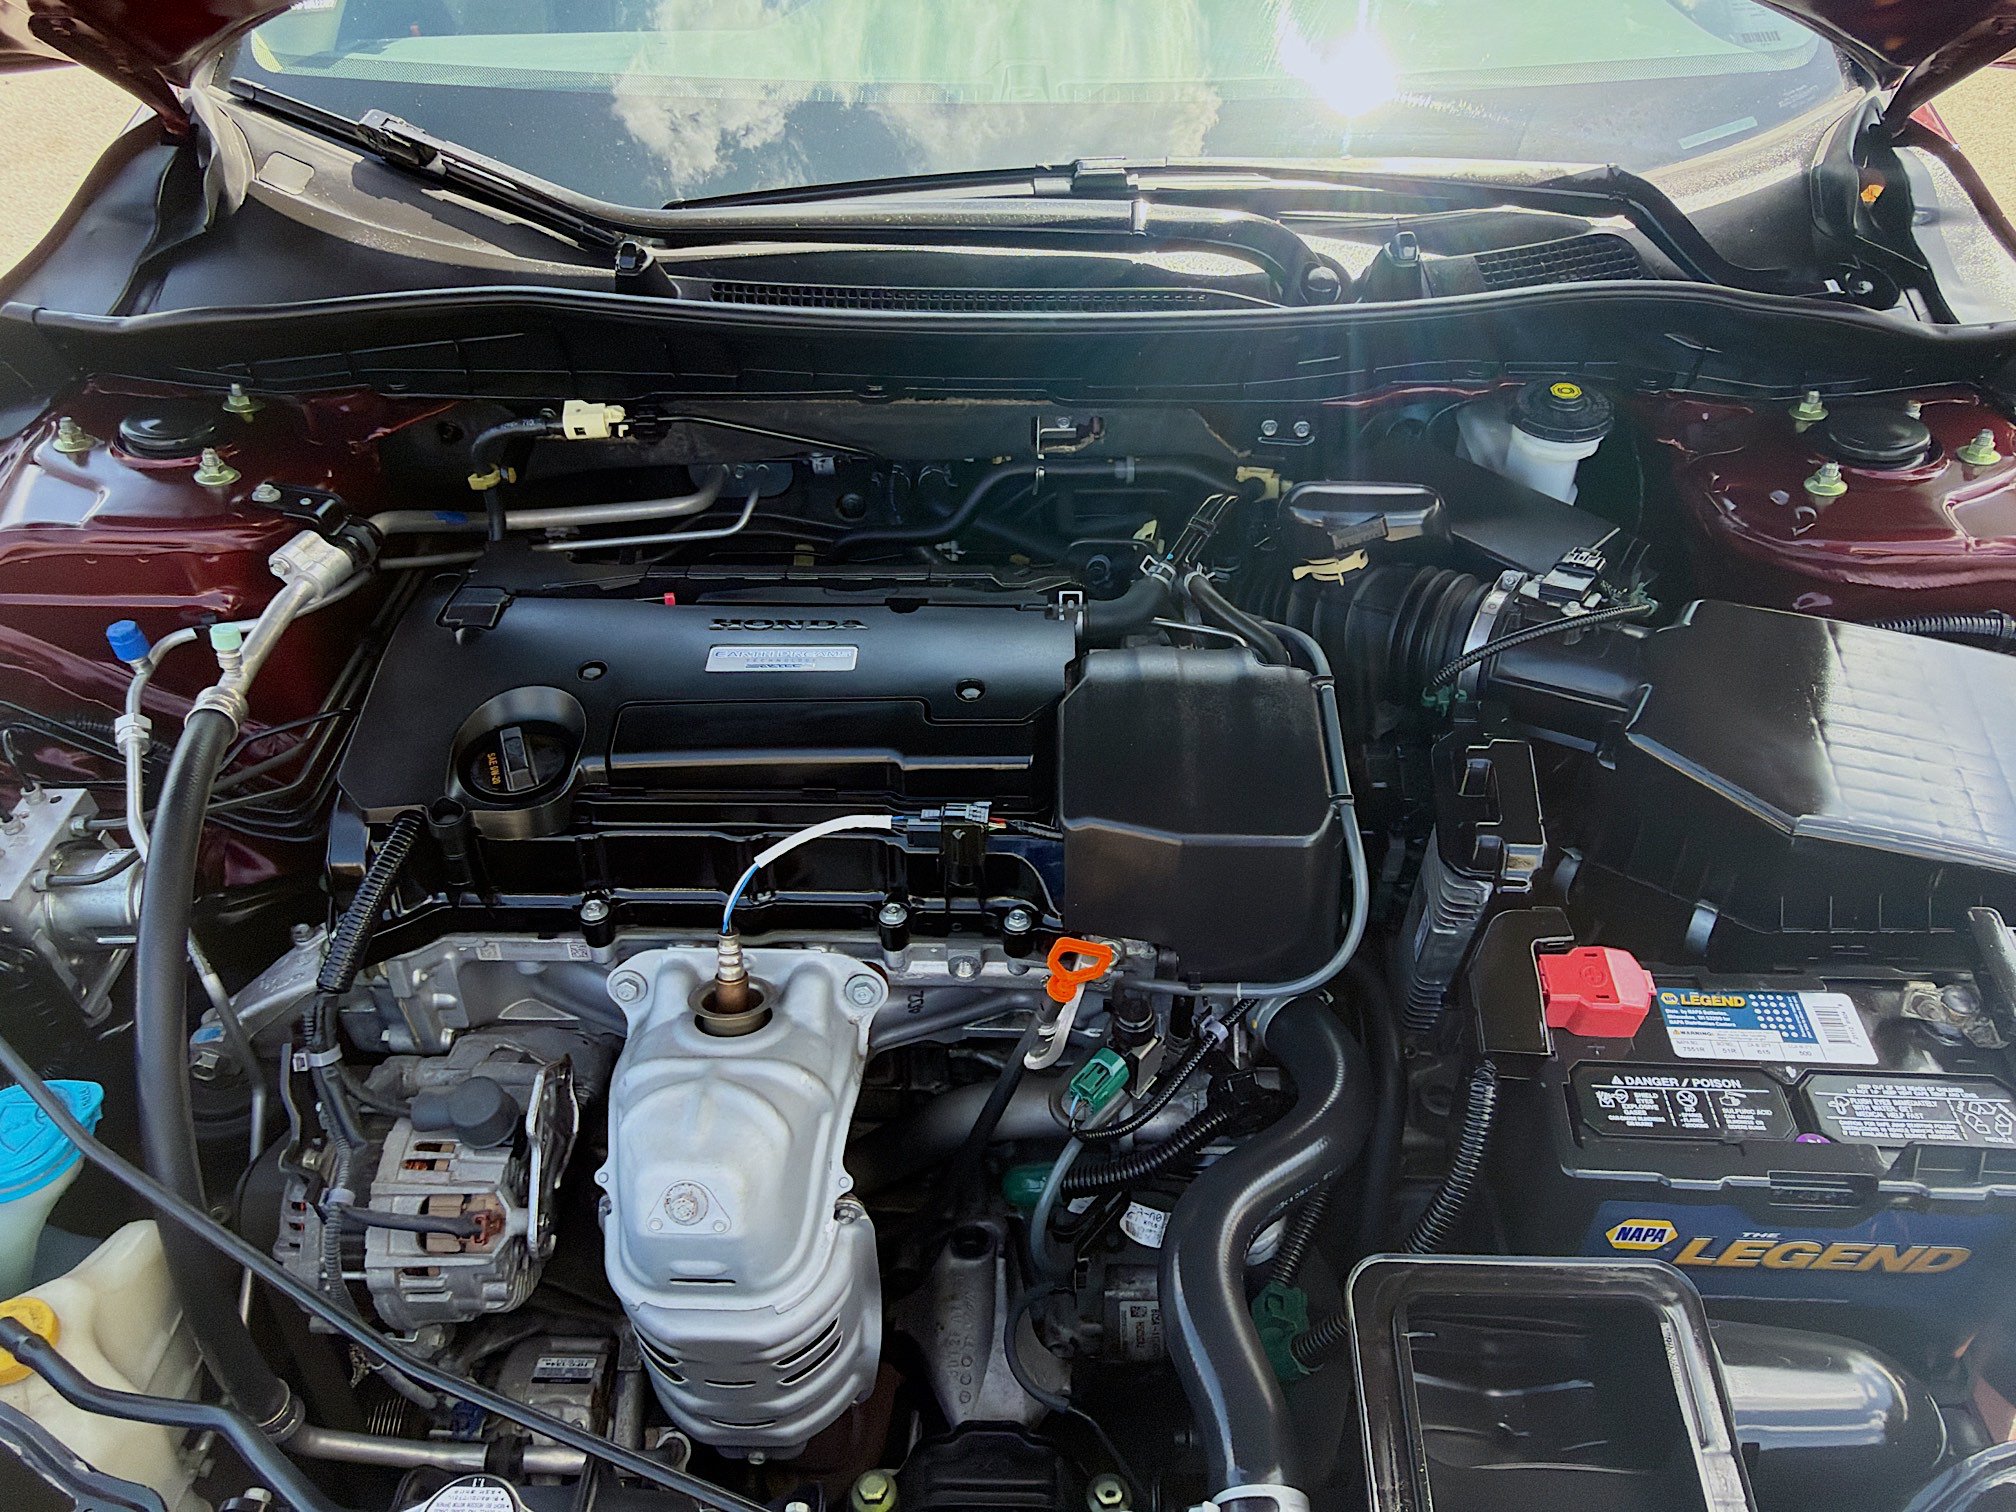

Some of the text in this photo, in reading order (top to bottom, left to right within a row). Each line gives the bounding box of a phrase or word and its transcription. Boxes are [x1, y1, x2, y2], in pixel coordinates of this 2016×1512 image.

[709, 618, 869, 631] HONDA
[487, 752, 498, 765] SAE
[1680, 994, 1746, 1008] LEGEND
[1624, 1076, 1742, 1089] DANGER / POISON
[1849, 1097, 1938, 1107] FLUSH EYES IMMEDIATELY
[1855, 1110, 1924, 1120] MEDICAL HELP FAST
[1613, 1225, 1668, 1244] NAPA
[1741, 1231, 1781, 1240] THE
[1673, 1235, 1972, 1274] LEGEND
